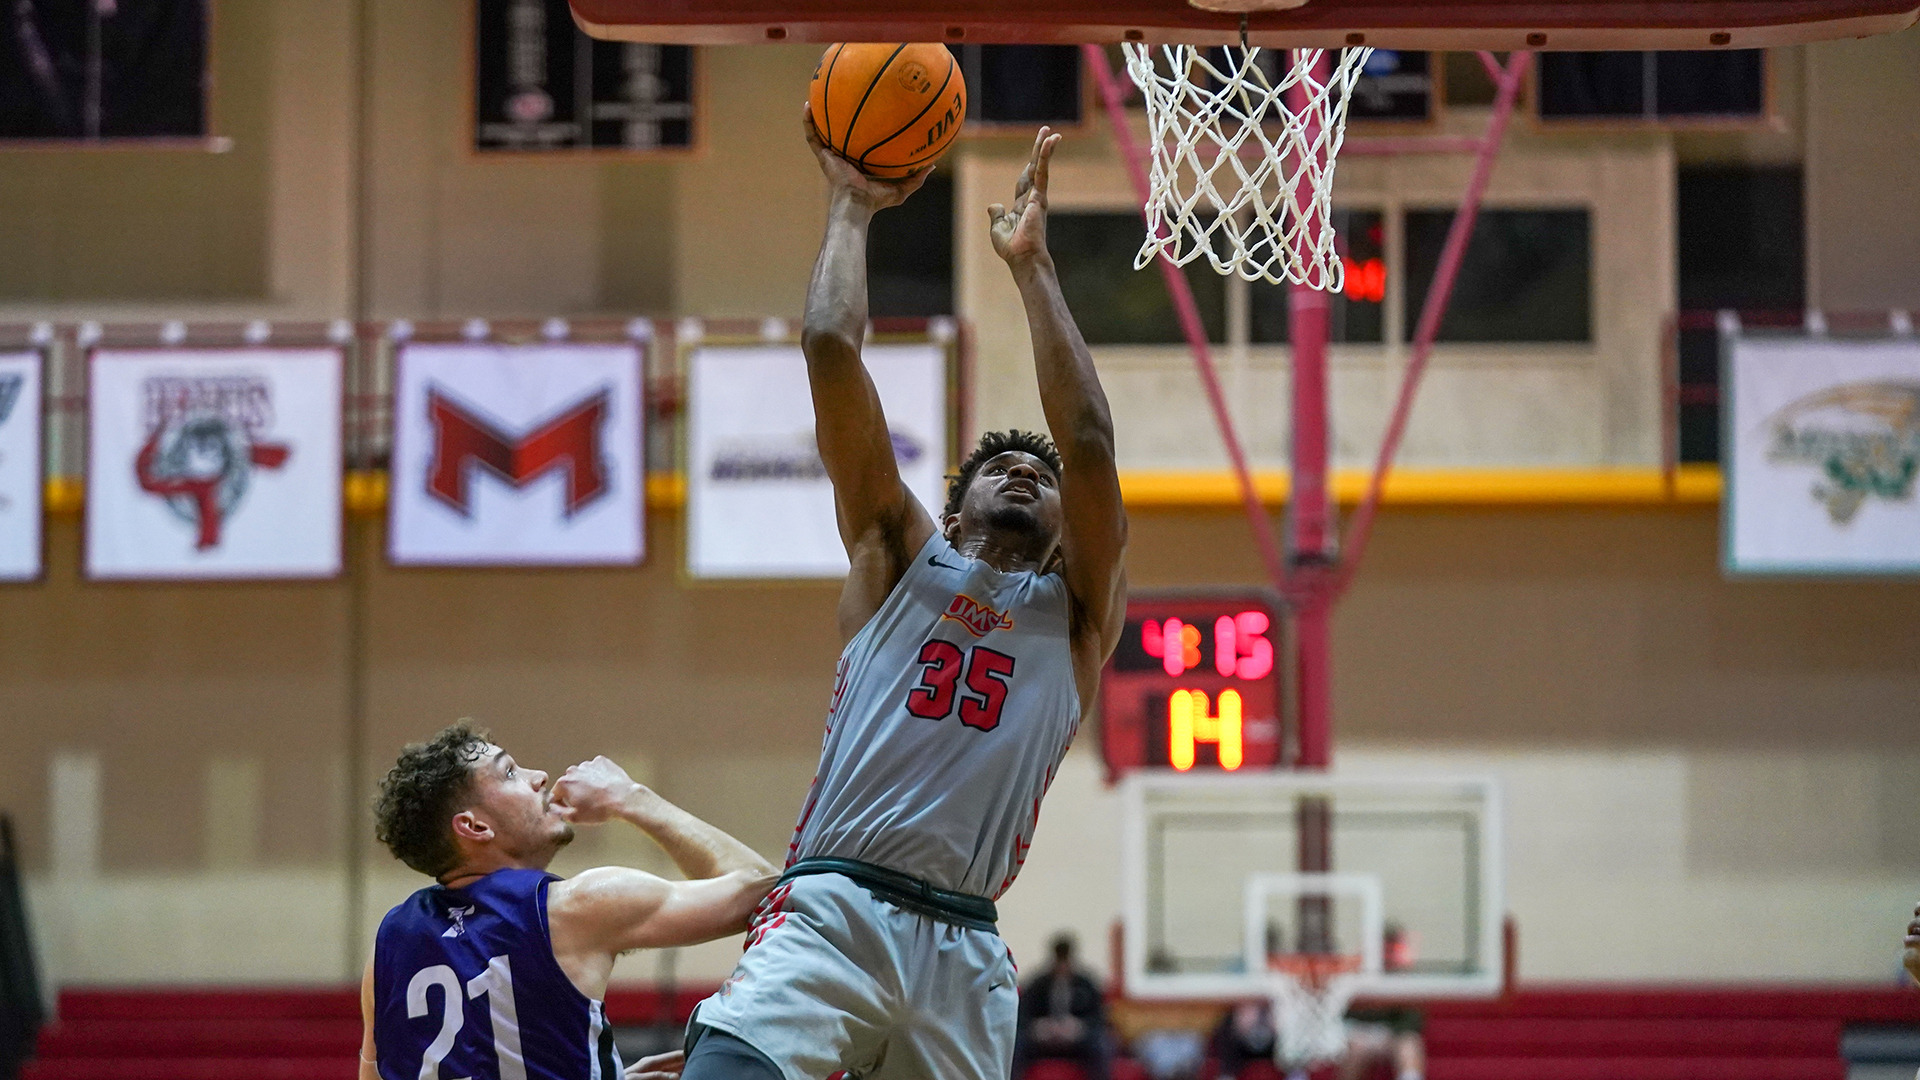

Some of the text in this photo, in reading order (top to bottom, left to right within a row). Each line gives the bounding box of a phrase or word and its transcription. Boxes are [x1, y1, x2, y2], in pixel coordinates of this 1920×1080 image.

[926, 92, 962, 147] EVO
[943, 593, 1014, 637] UMSL
[905, 639, 1016, 732] 35
[1170, 688, 1243, 772] 14
[406, 954, 527, 1080] 21
